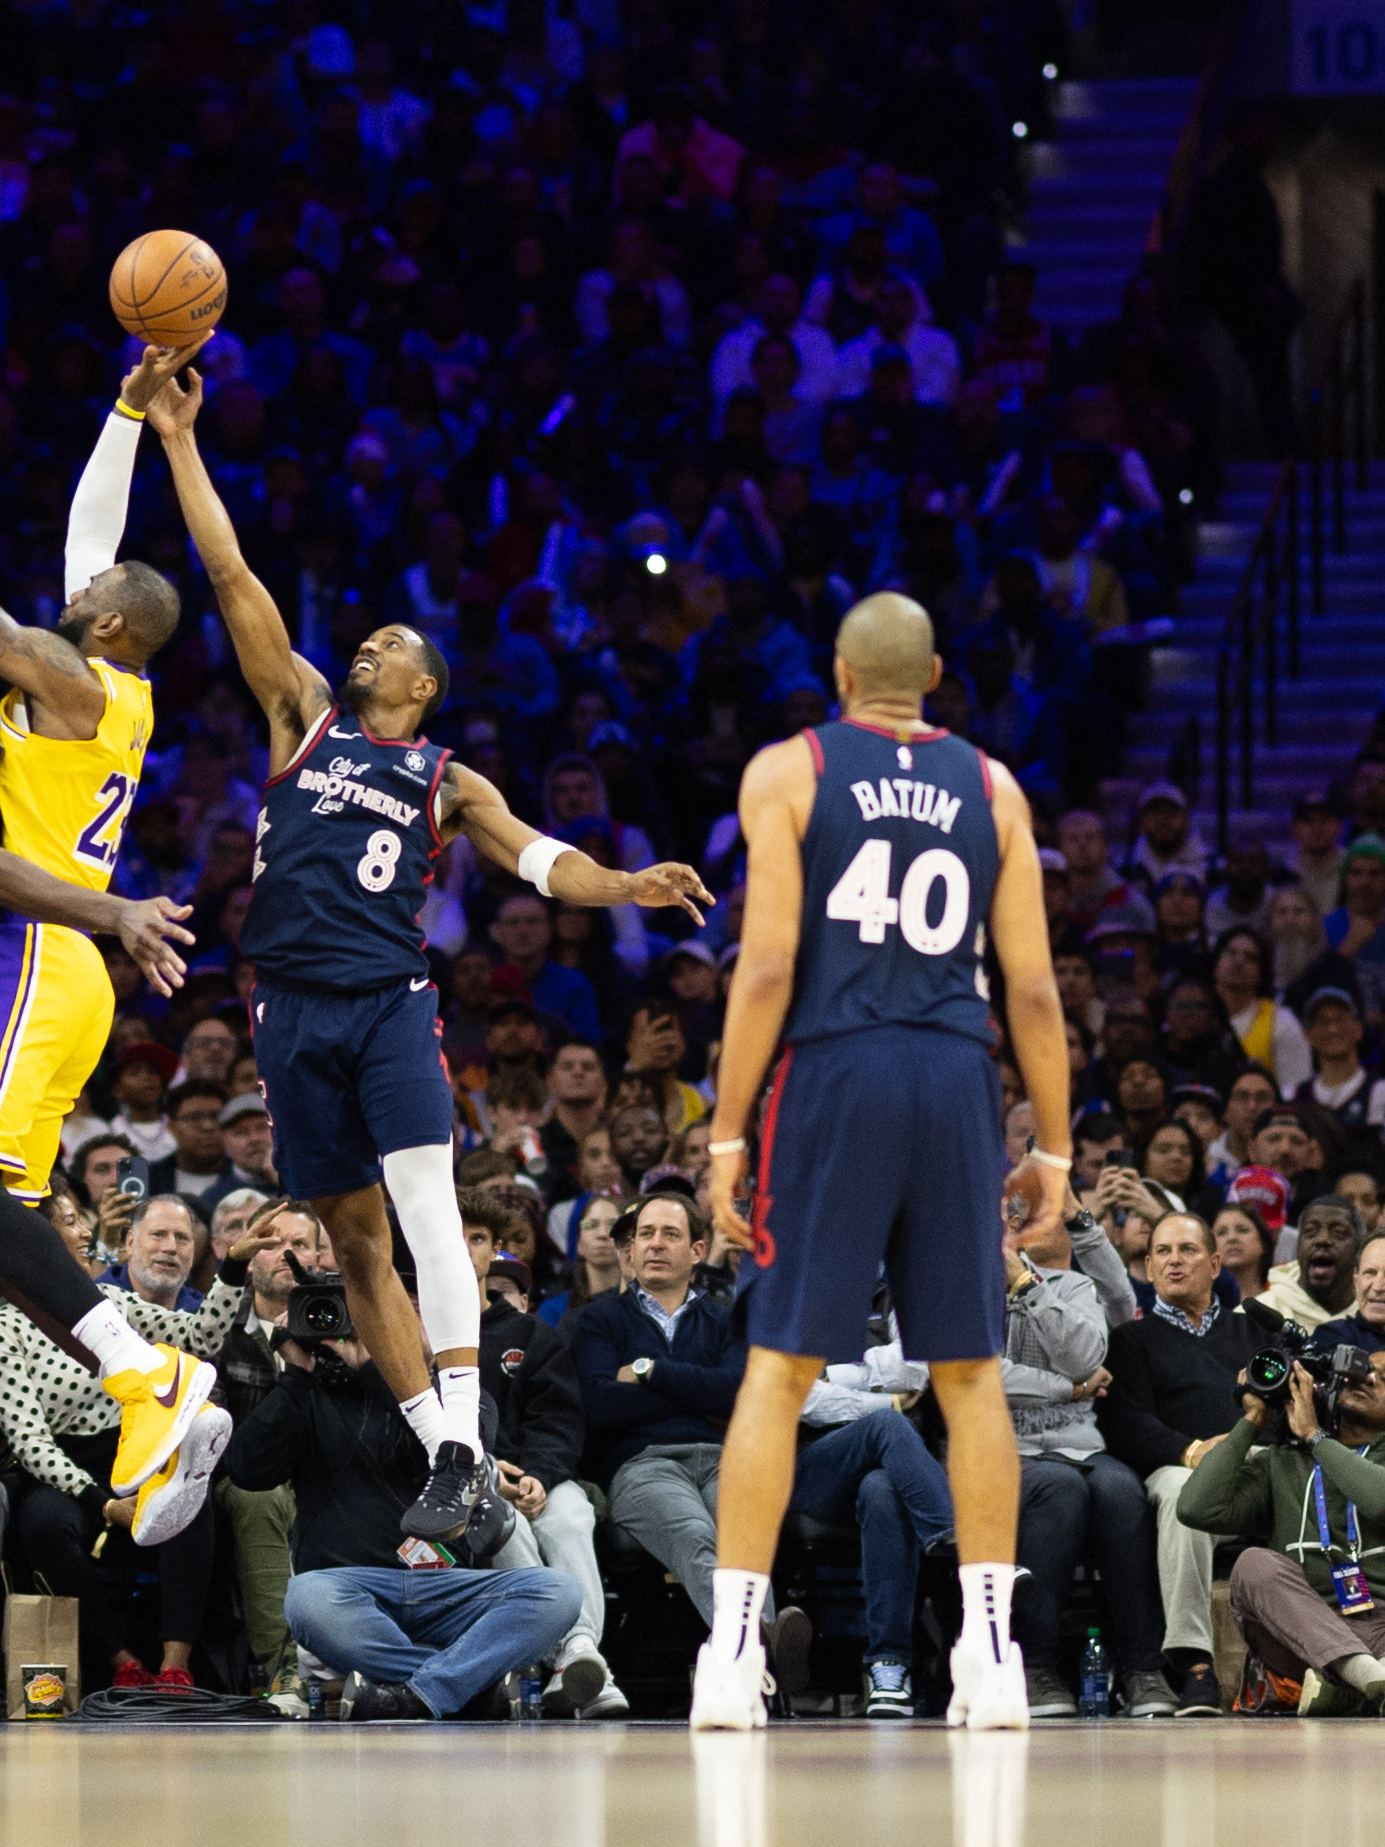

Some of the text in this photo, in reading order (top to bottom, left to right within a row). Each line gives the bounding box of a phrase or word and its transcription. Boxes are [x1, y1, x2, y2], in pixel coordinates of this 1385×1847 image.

[329, 756, 355, 778] City
[72, 770, 138, 875] 2
[297, 768, 421, 827] BROTHERLY
[311, 793, 345, 815] Love
[849, 777, 963, 835] BATUM
[357, 829, 402, 893] 8
[826, 838, 970, 956] 40
